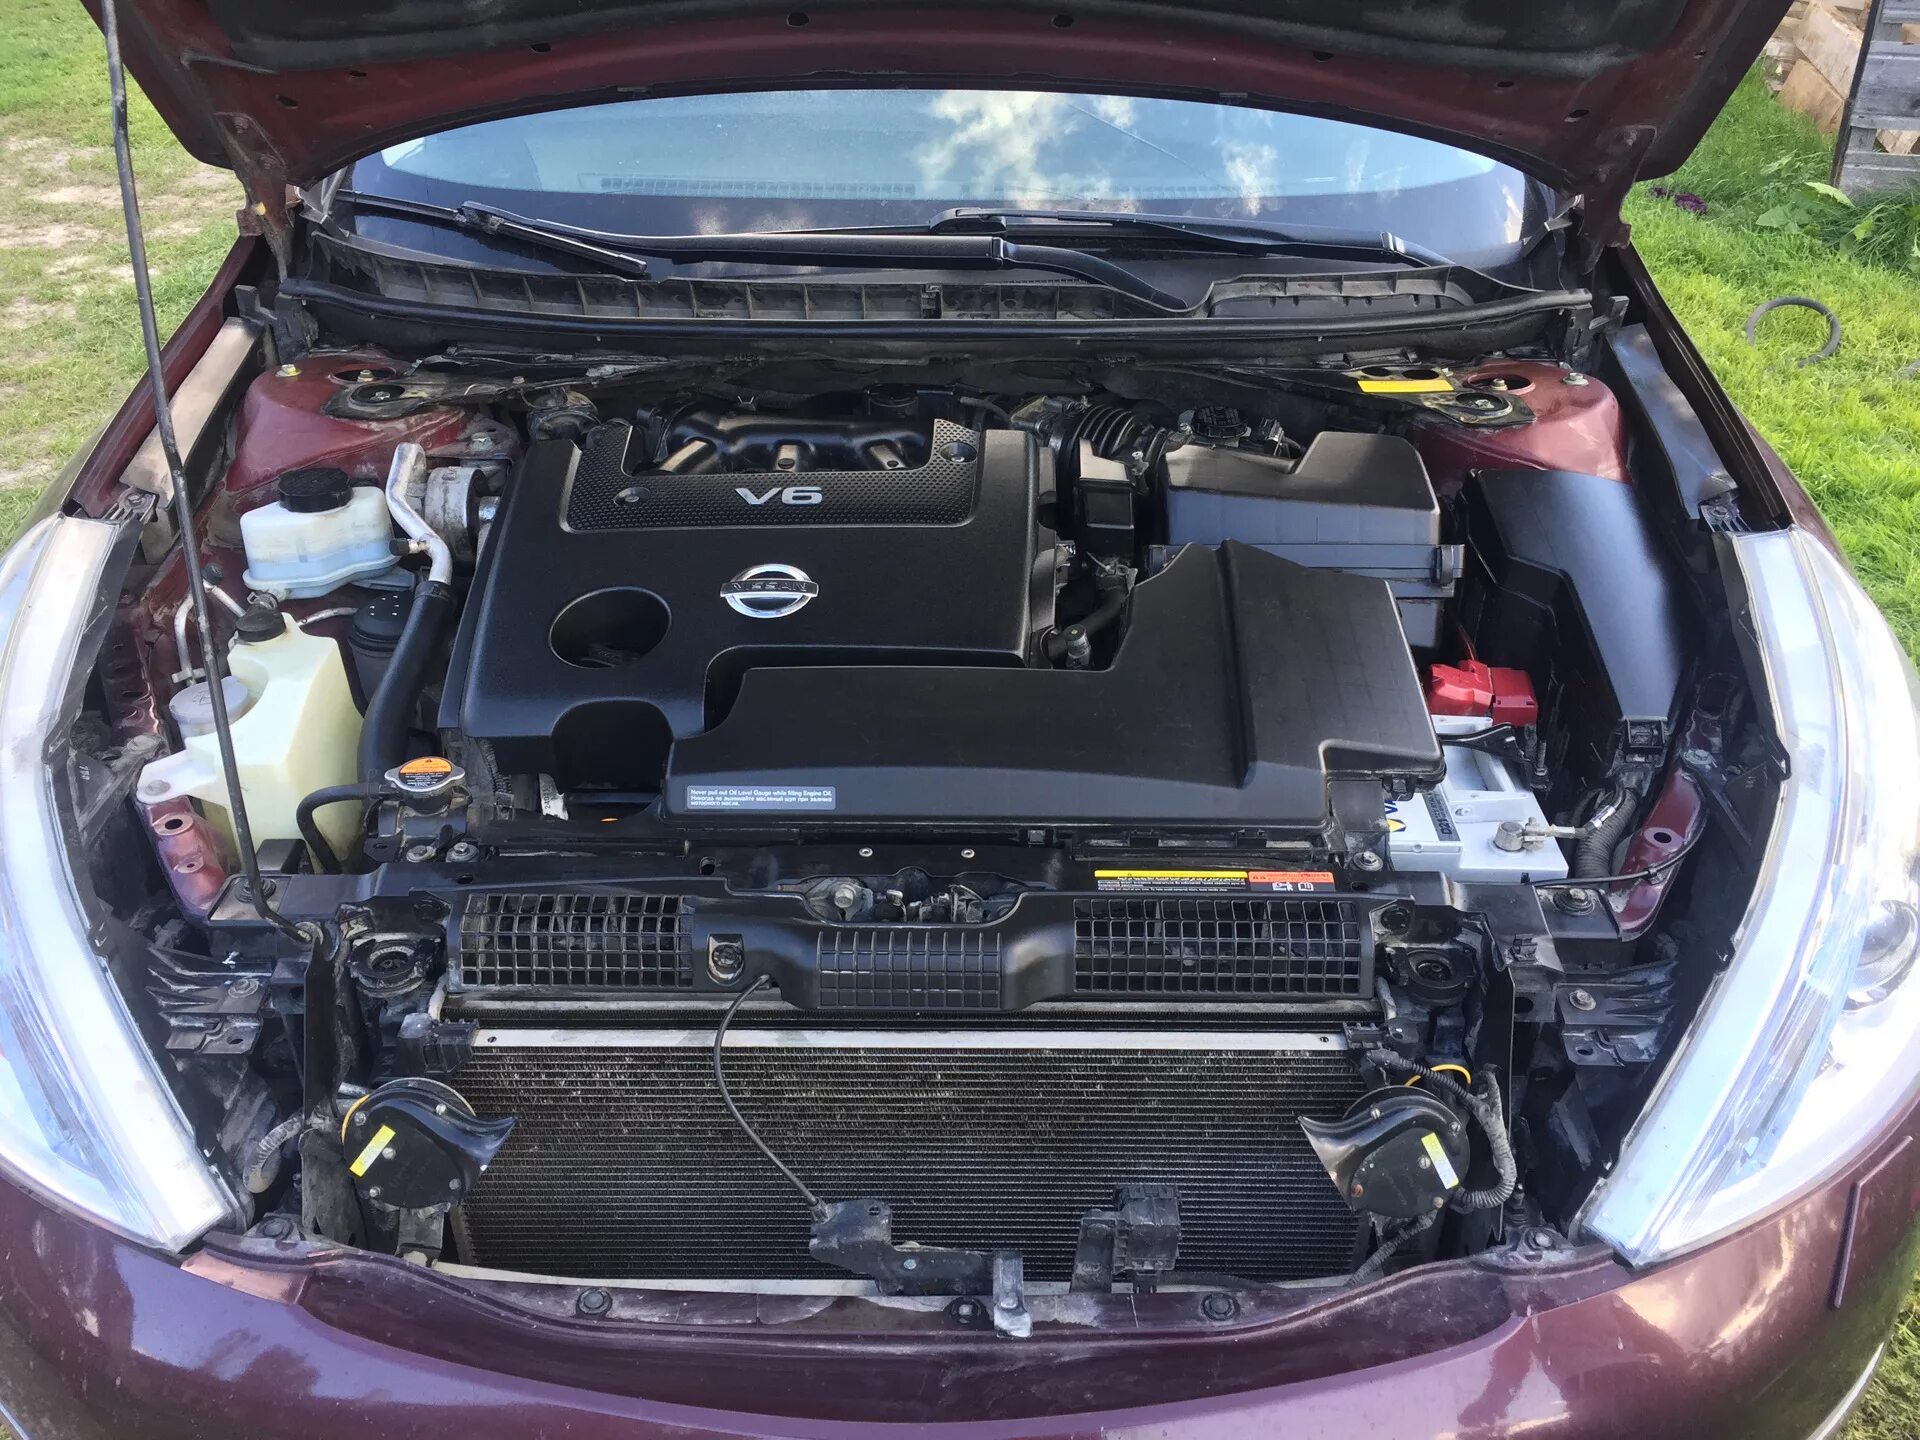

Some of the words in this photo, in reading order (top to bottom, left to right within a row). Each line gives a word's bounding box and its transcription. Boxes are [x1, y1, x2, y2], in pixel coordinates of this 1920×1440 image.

[735, 486, 823, 505] V6
[731, 581, 808, 592] NISSAN
[1437, 819, 1453, 835] D21
